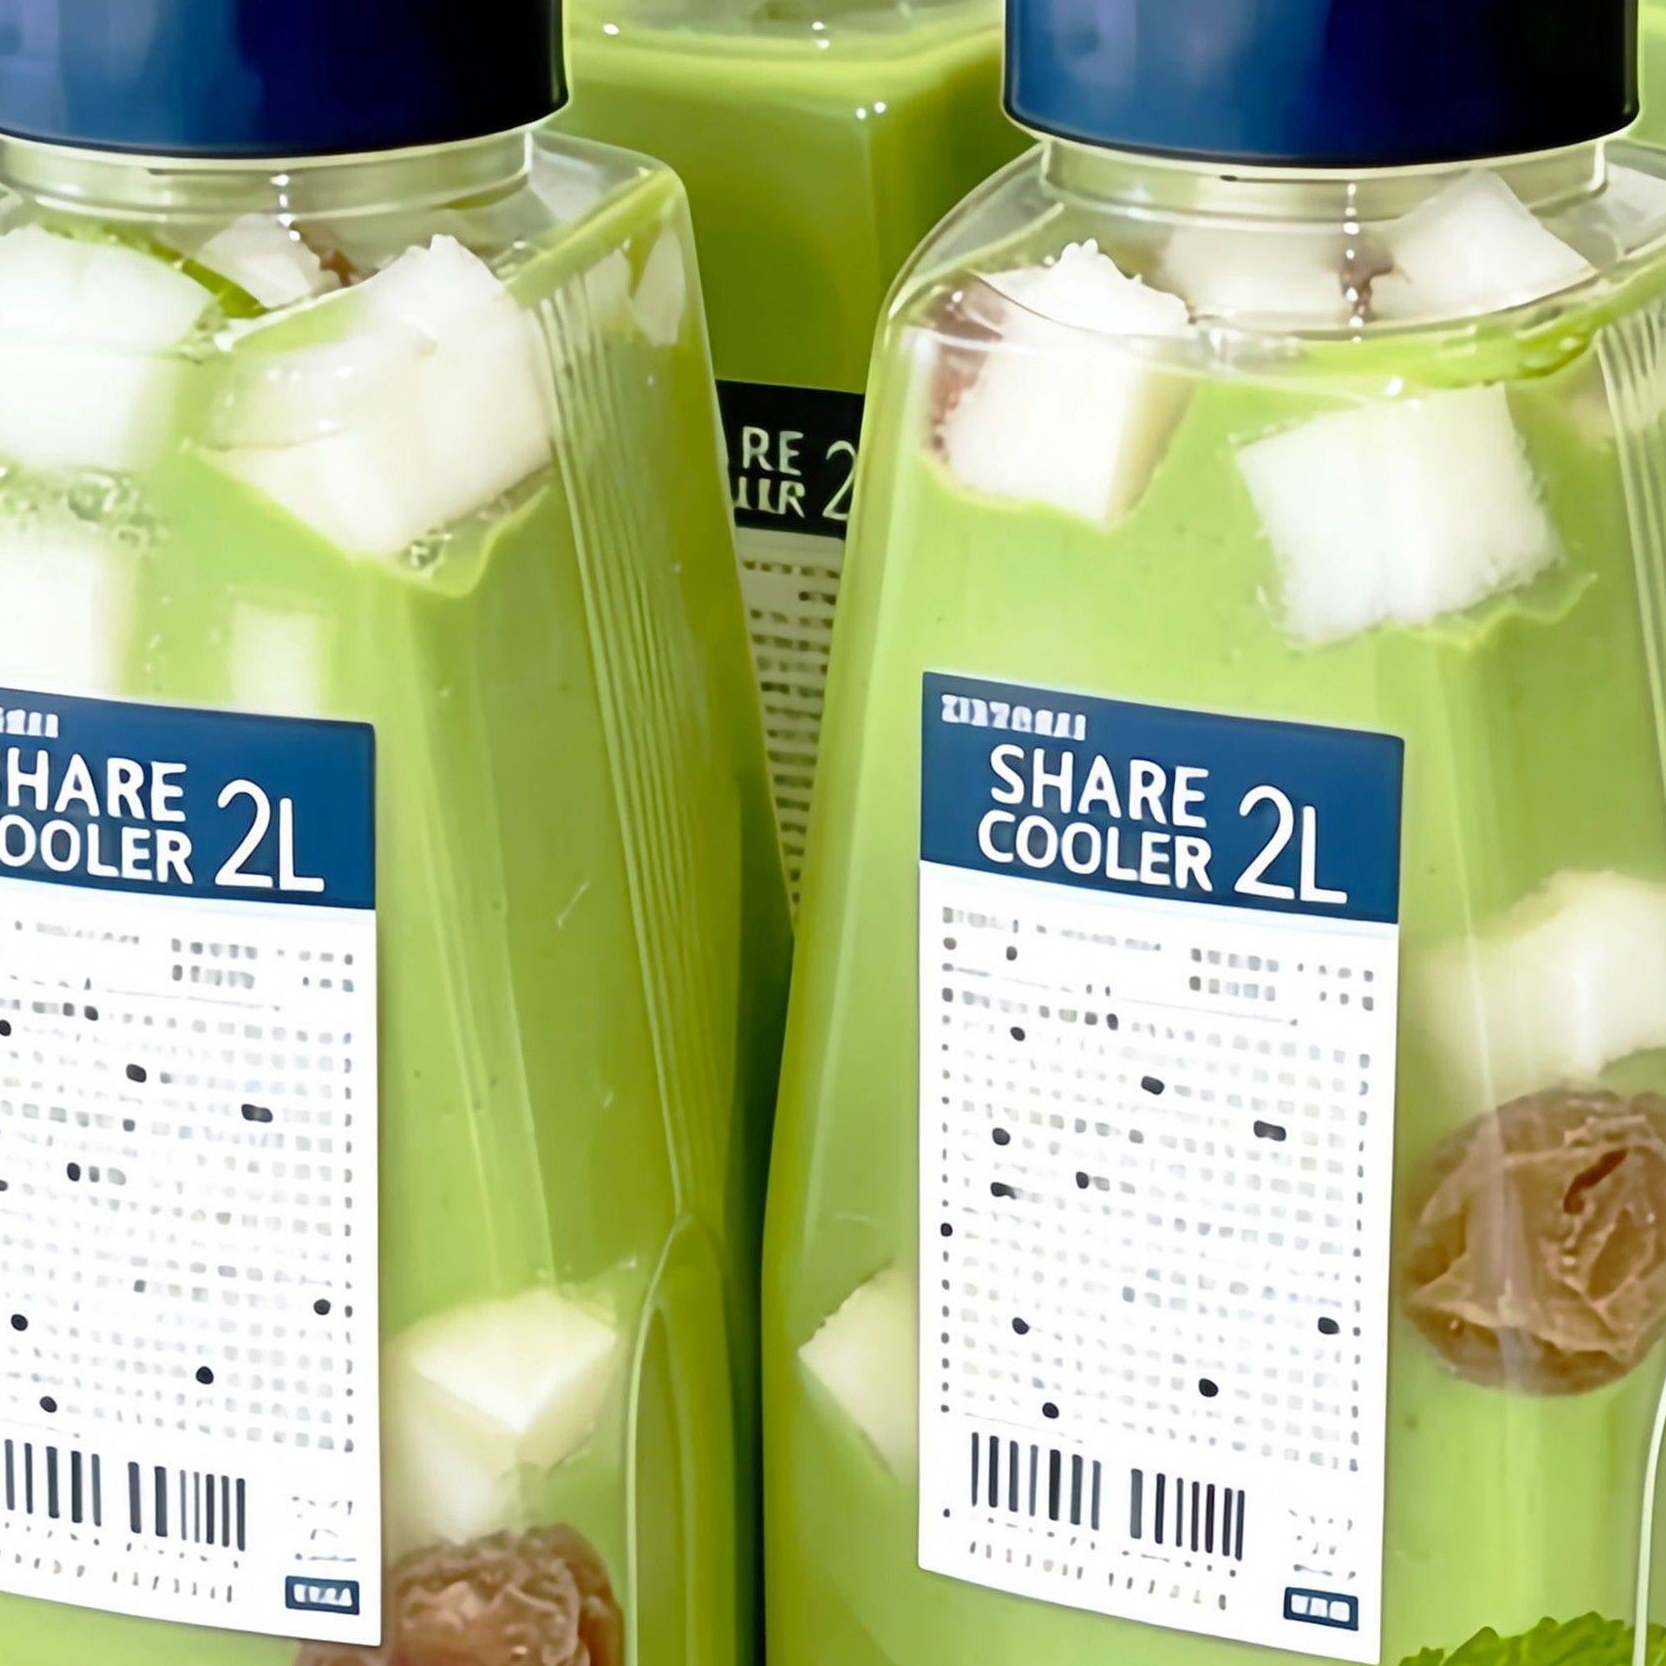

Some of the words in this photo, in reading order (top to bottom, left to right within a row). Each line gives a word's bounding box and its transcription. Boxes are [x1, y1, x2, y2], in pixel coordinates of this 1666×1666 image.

[822, 440, 858, 521] 2
[990, 744, 1209, 828] SHARE
[215, 779, 325, 893] 2L
[978, 809, 1213, 892] COOLER
[1234, 785, 1348, 904] 2L
